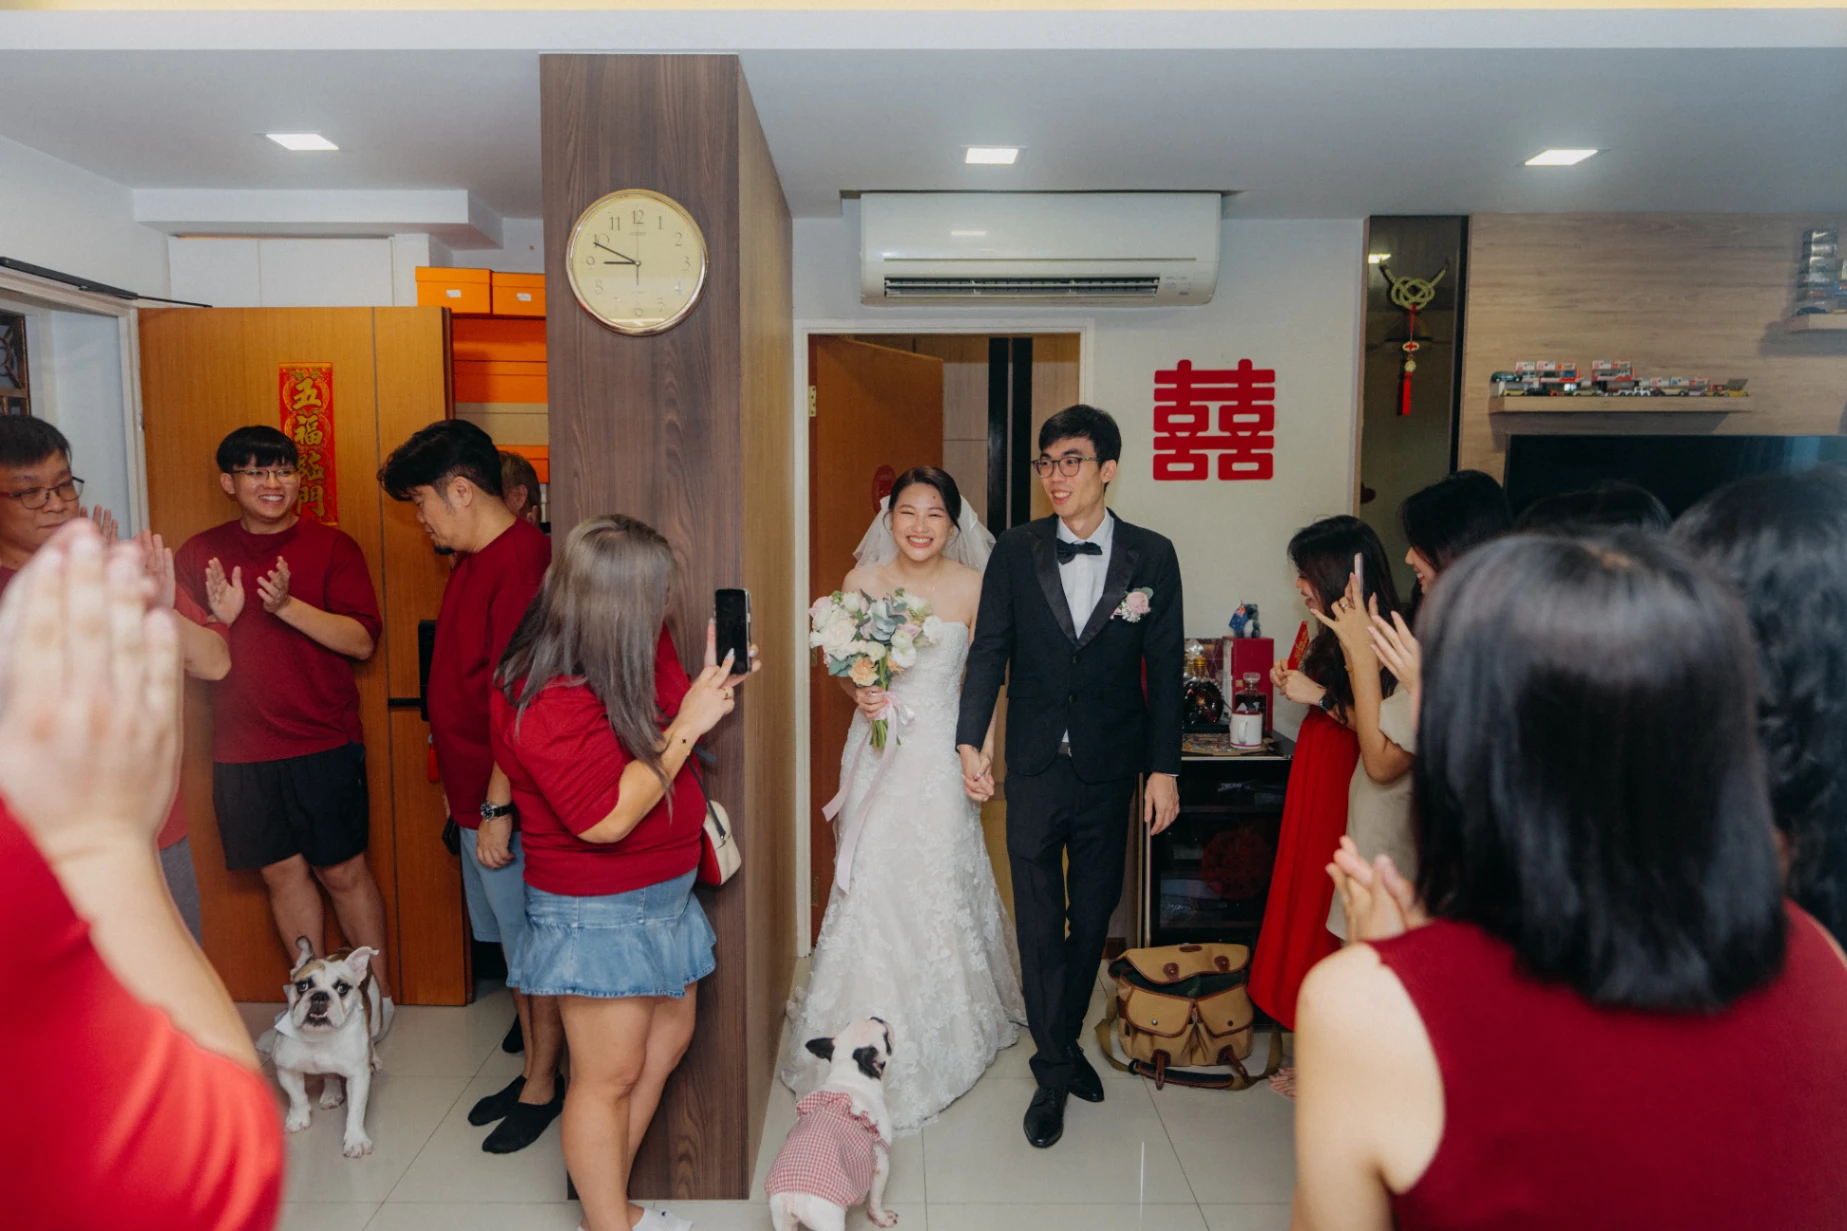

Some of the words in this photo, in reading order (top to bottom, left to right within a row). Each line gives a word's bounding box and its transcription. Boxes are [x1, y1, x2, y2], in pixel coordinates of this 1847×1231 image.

[610, 216, 621, 231] 11
[632, 210, 644, 225] 12
[658, 215, 663, 230] 1
[593, 233, 610, 248] 10
[675, 232, 683, 247] 2
[586, 256, 595, 271] 9
[683, 256, 691, 271] 3
[594, 280, 604, 295] 8
[634, 303, 644, 318] 6
